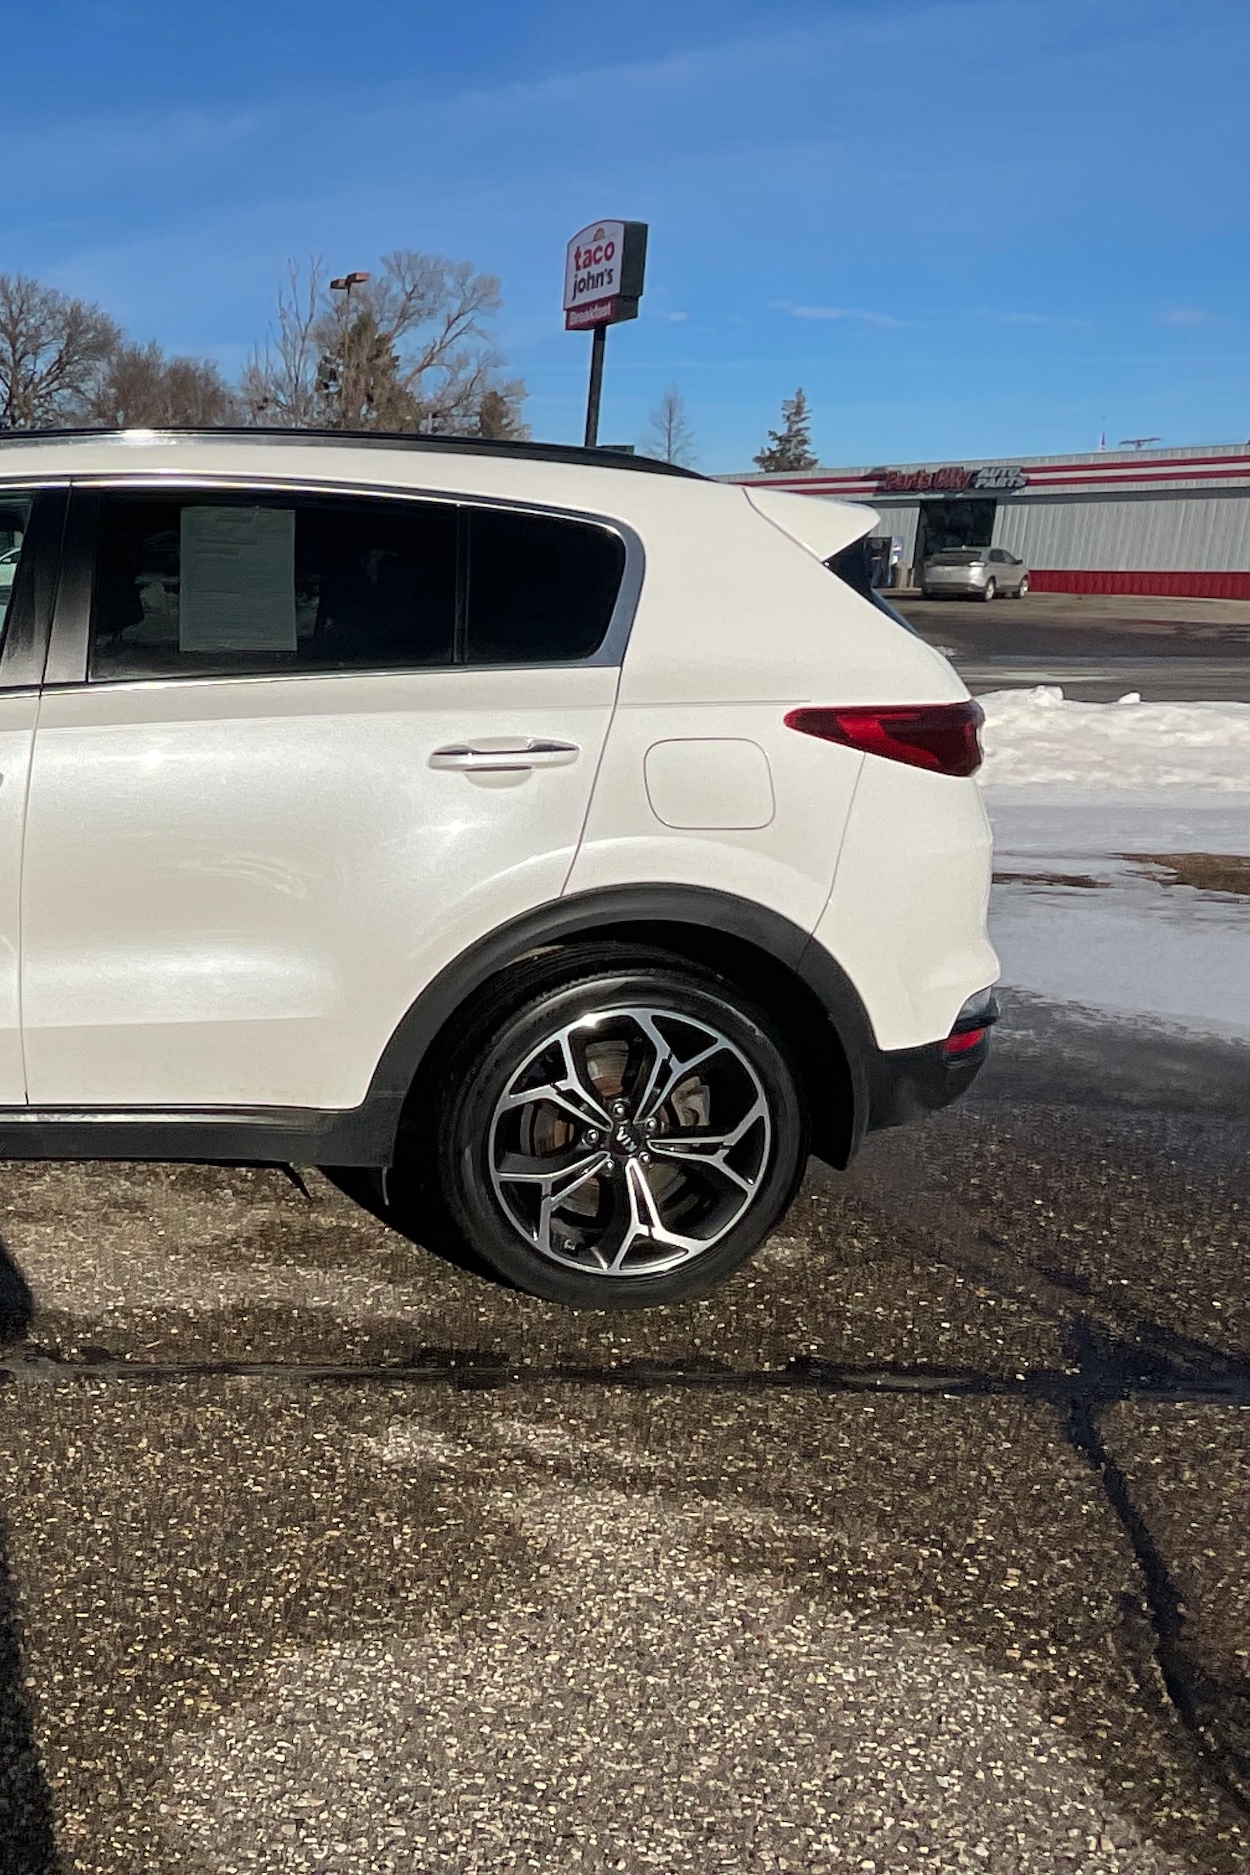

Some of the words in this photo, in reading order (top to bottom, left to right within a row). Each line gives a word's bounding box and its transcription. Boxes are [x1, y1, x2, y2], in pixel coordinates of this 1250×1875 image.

[574, 240, 615, 271] taco
[572, 268, 614, 301] john's
[975, 476, 1030, 489] PARTS
[977, 466, 1022, 478] AUTO
